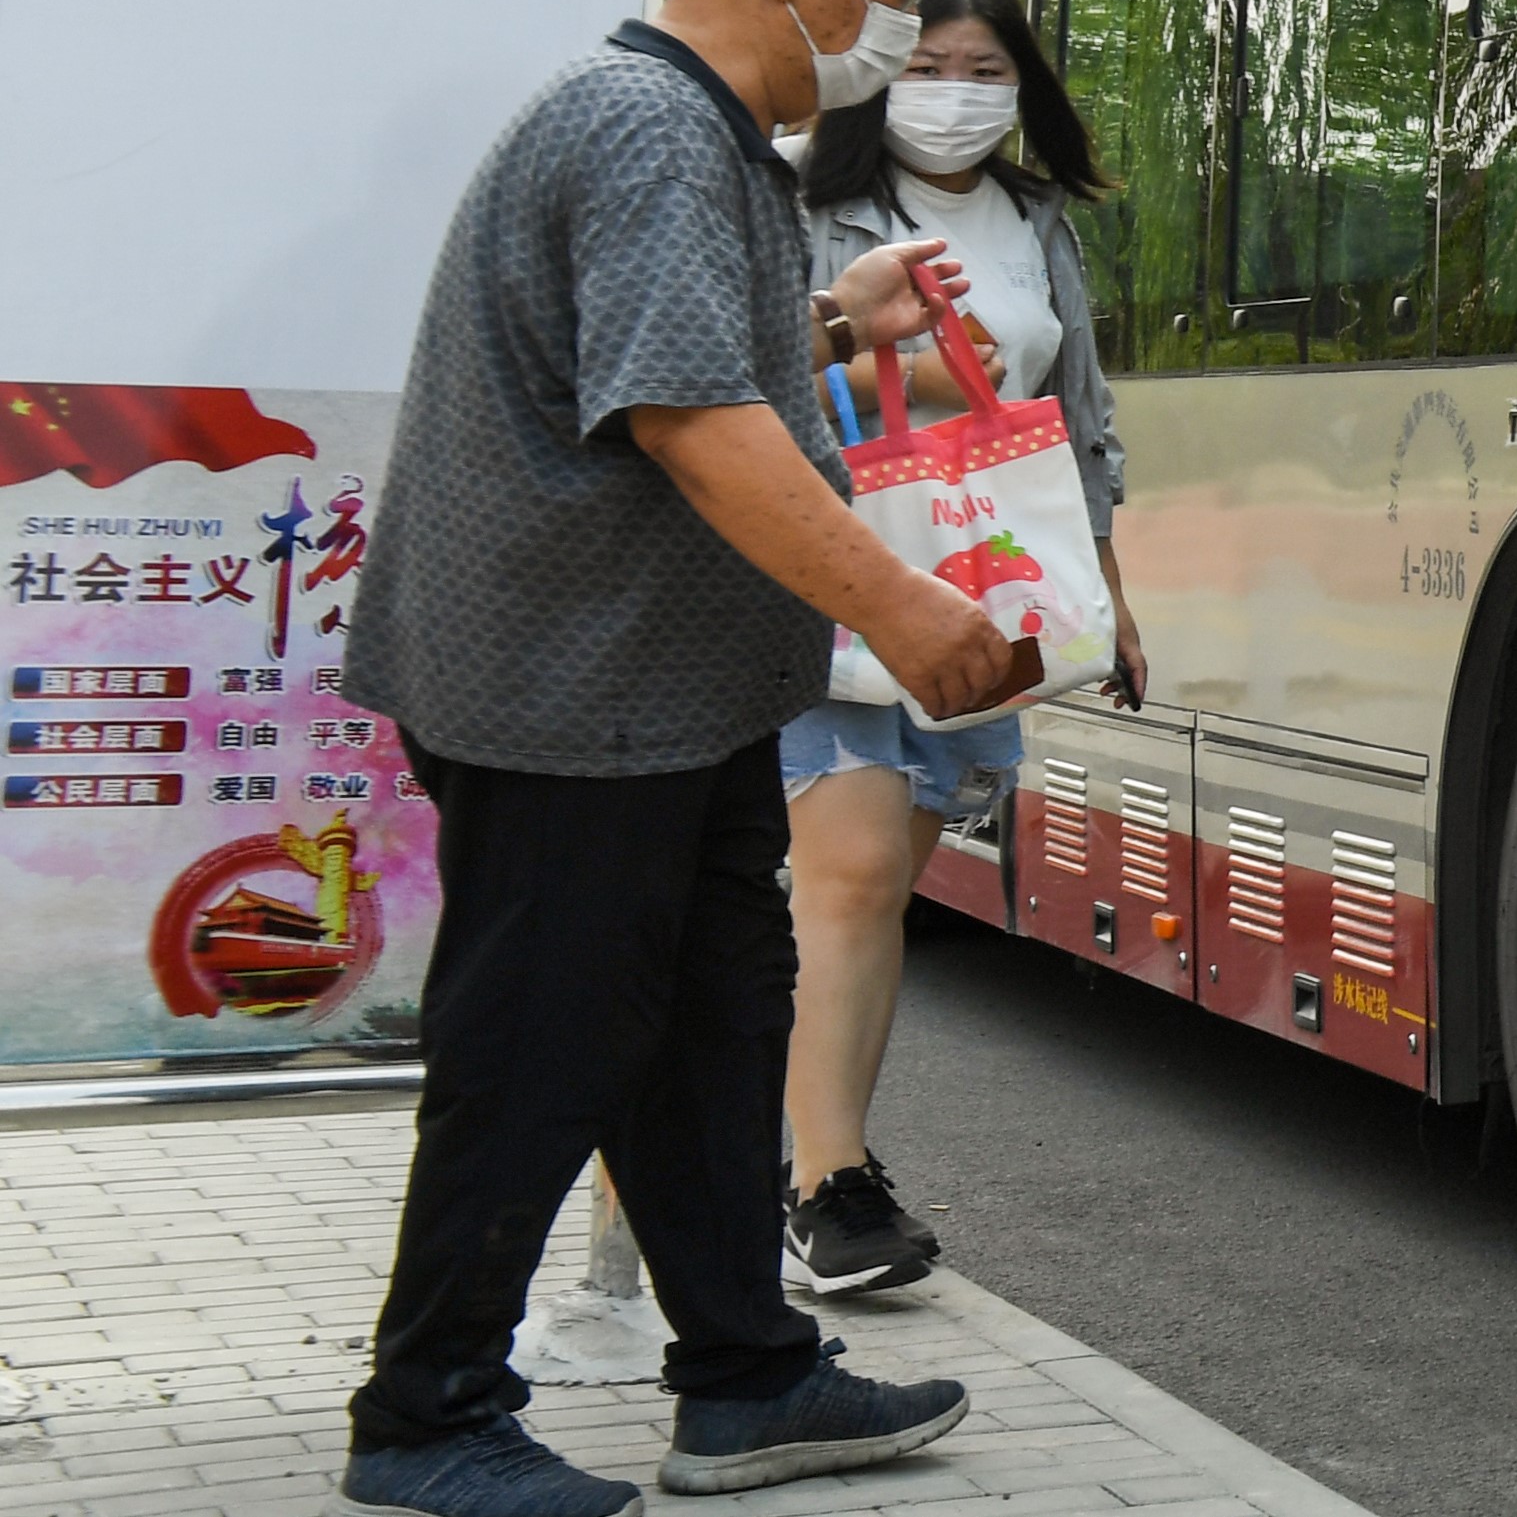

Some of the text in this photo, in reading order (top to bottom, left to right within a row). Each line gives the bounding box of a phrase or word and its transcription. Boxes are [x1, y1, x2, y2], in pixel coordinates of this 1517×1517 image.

[24, 516, 223, 537] SHE HUI ZHU YI
[11, 552, 256, 604] 社会主义
[1400, 544, 1466, 602] 4-3336
[40, 669, 169, 695] 国家层面
[222, 668, 284, 694] 富强
[34, 721, 373, 750] 社会层面 自由 平等
[30, 778, 163, 804] 公民层面
[213, 775, 277, 801] 爱国
[307, 774, 370, 800] 敬业
